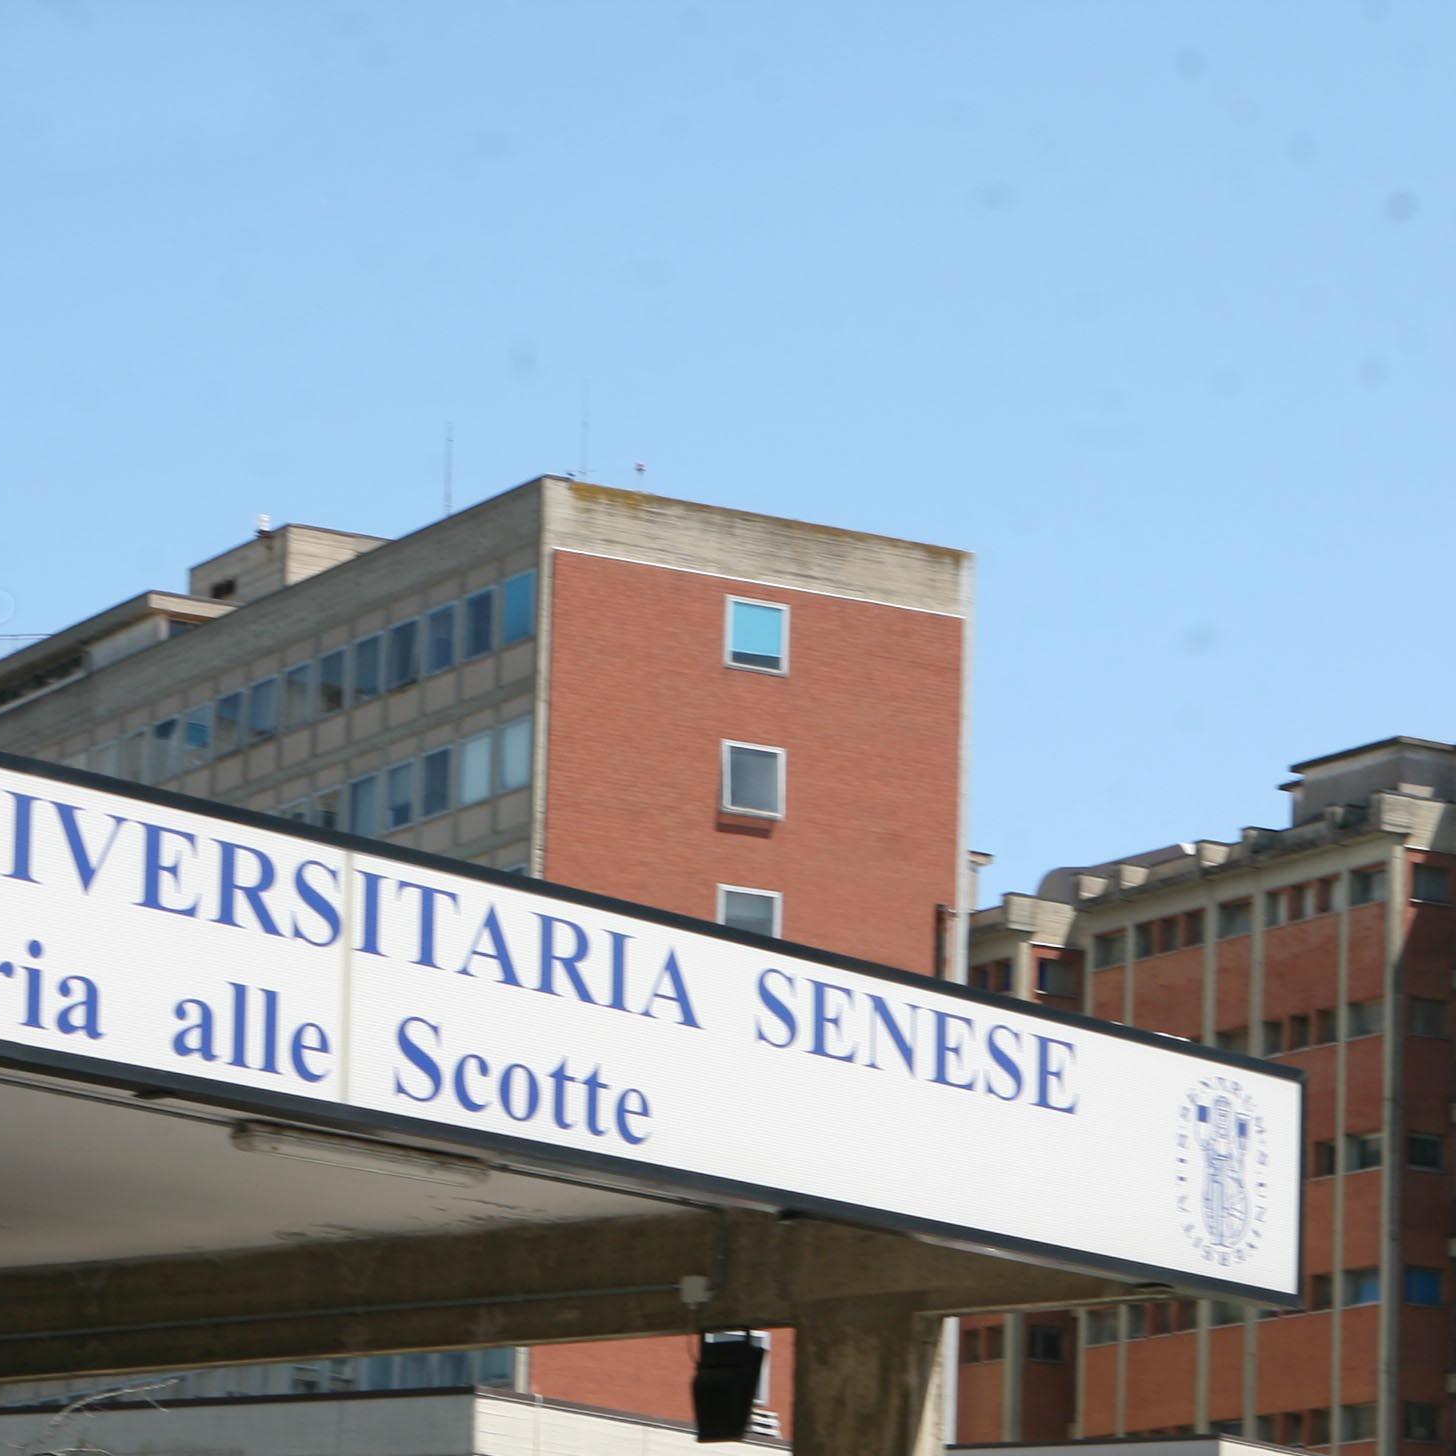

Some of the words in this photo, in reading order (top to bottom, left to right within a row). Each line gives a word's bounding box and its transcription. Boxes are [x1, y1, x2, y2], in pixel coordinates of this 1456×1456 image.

[172, 981, 330, 1083] alle
[395, 1017, 652, 1145] Scotte
[756, 968, 1078, 1114] SENESE
